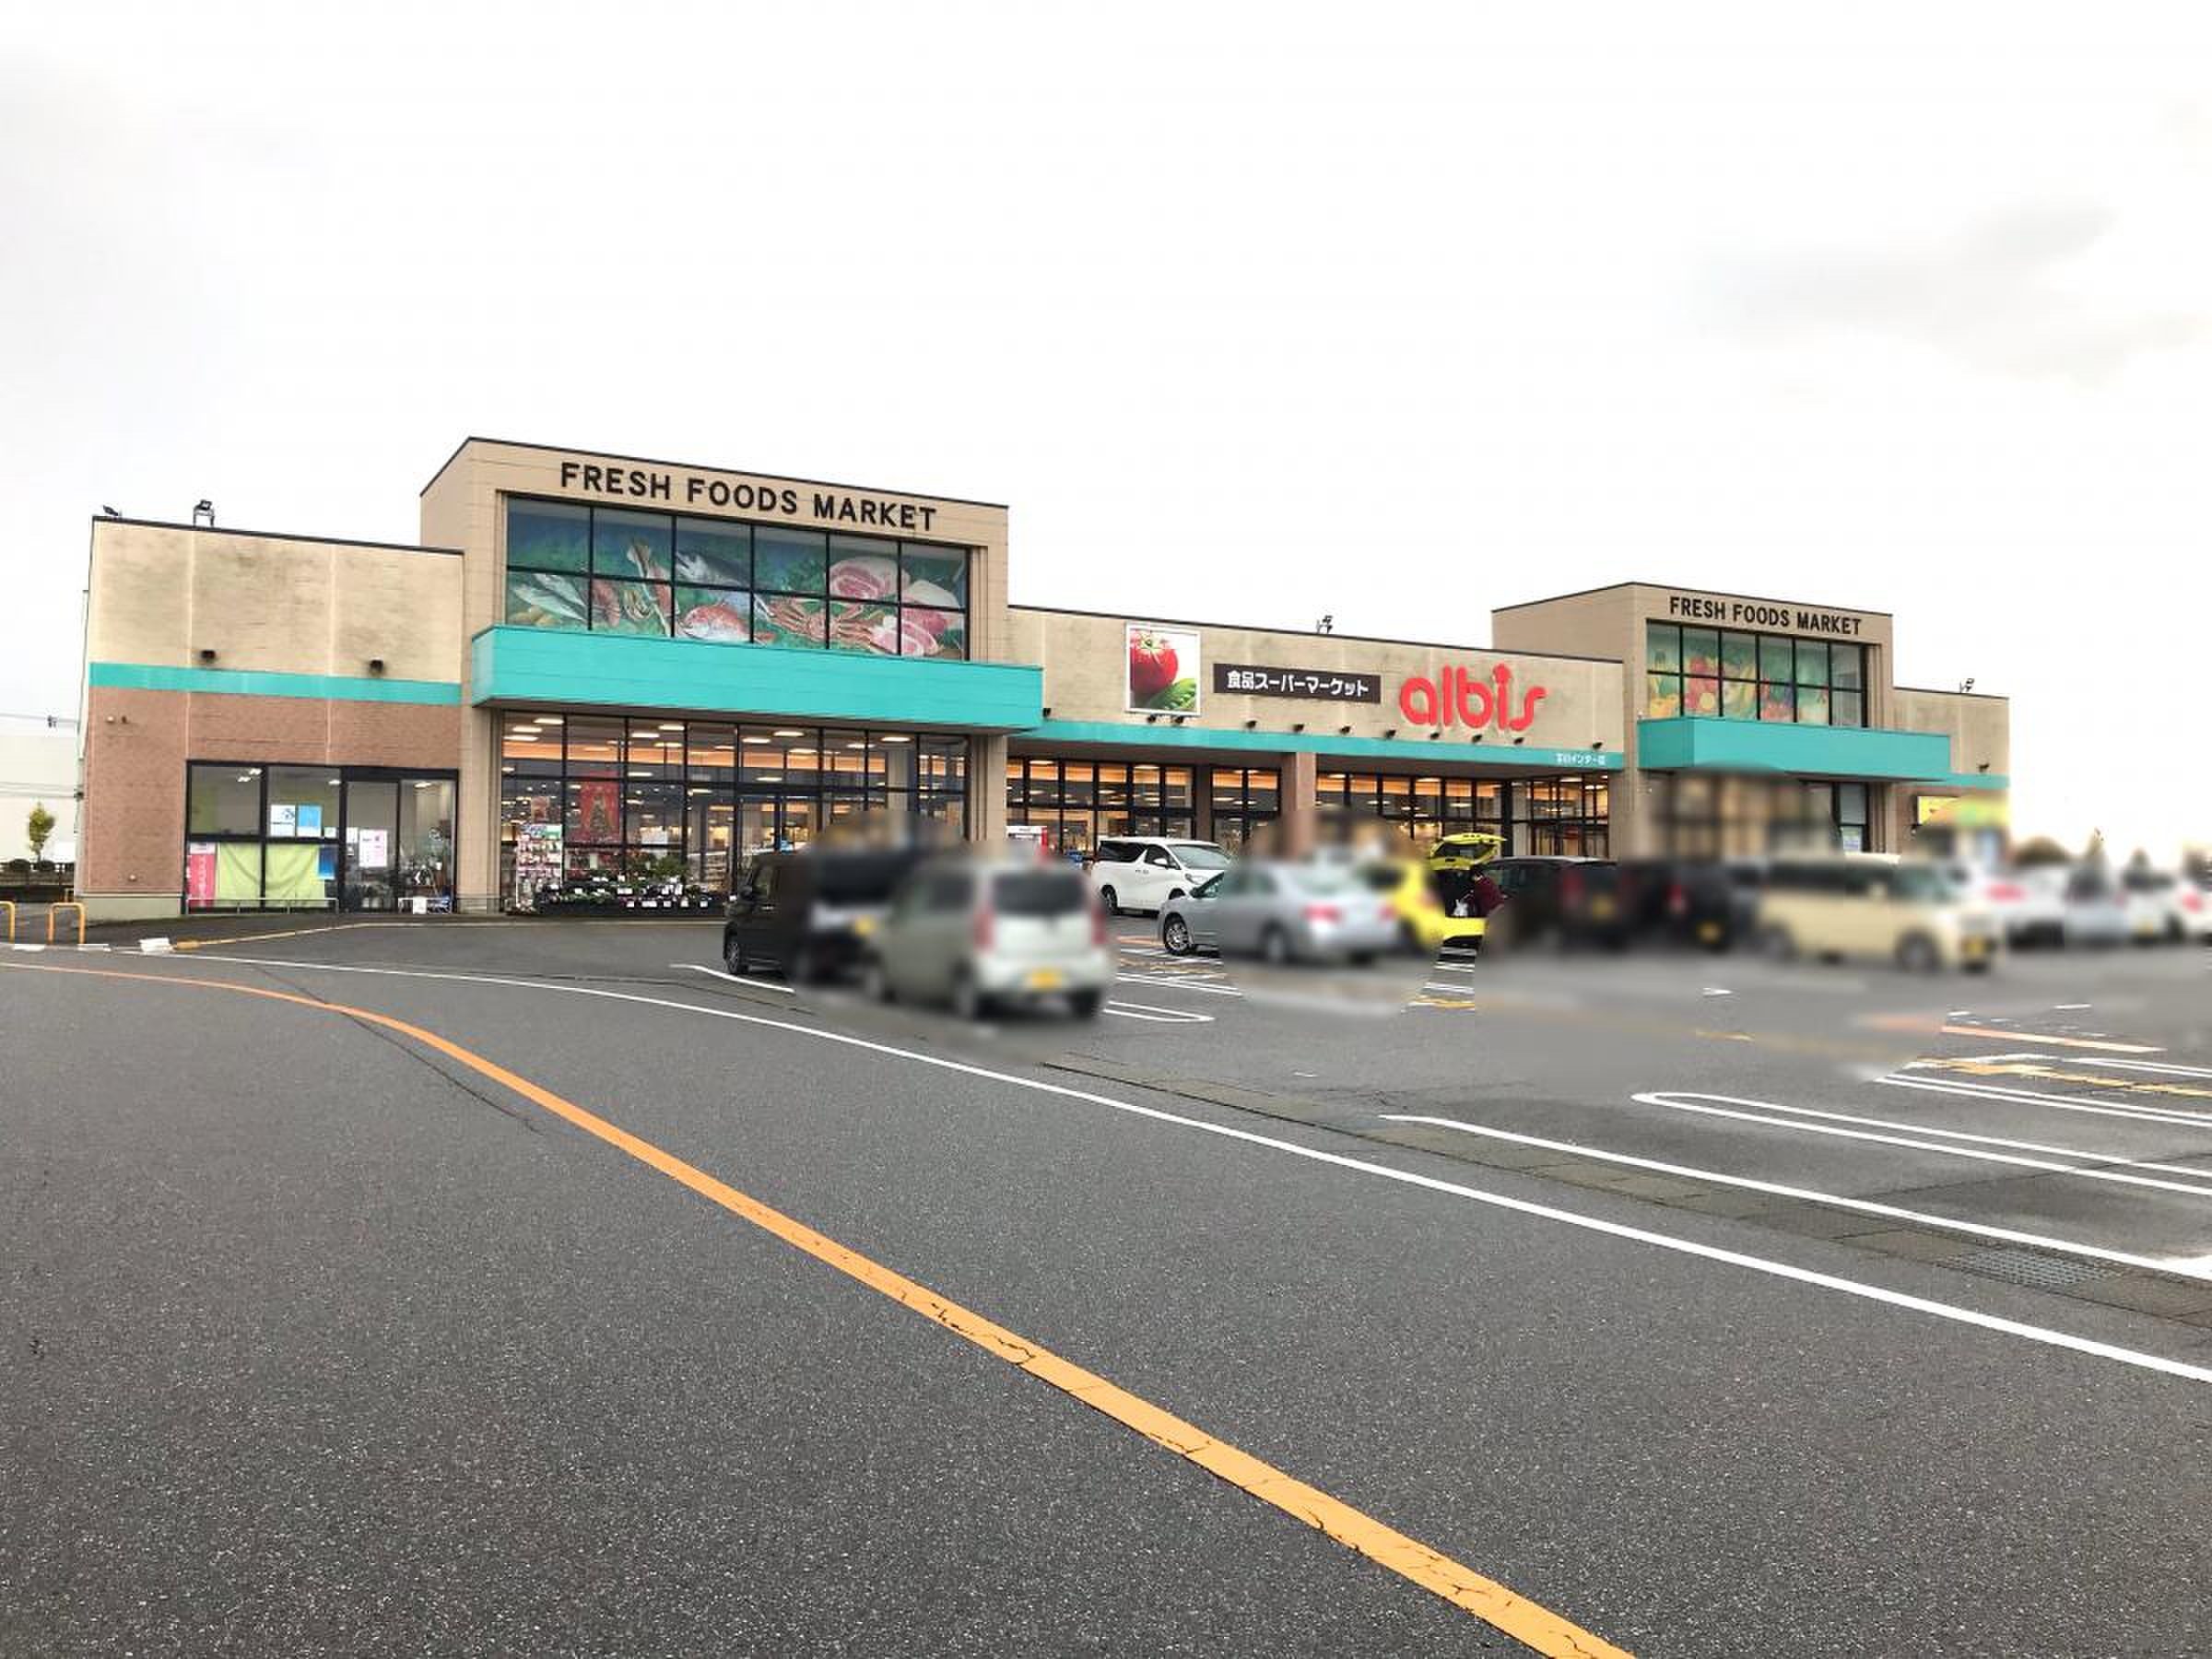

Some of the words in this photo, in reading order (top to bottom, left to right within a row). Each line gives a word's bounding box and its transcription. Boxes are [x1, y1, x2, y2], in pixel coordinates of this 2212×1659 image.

[560, 462, 671, 500] FRESH
[687, 477, 798, 515] FOODS
[813, 493, 937, 532] MARKET
[1669, 596, 1725, 619] FRESH
[1732, 604, 1790, 627] FOODS
[1796, 612, 1862, 635] MARKET
[1227, 669, 1370, 698] 食品スーパーマーケット
[1399, 663, 1547, 731] albis
